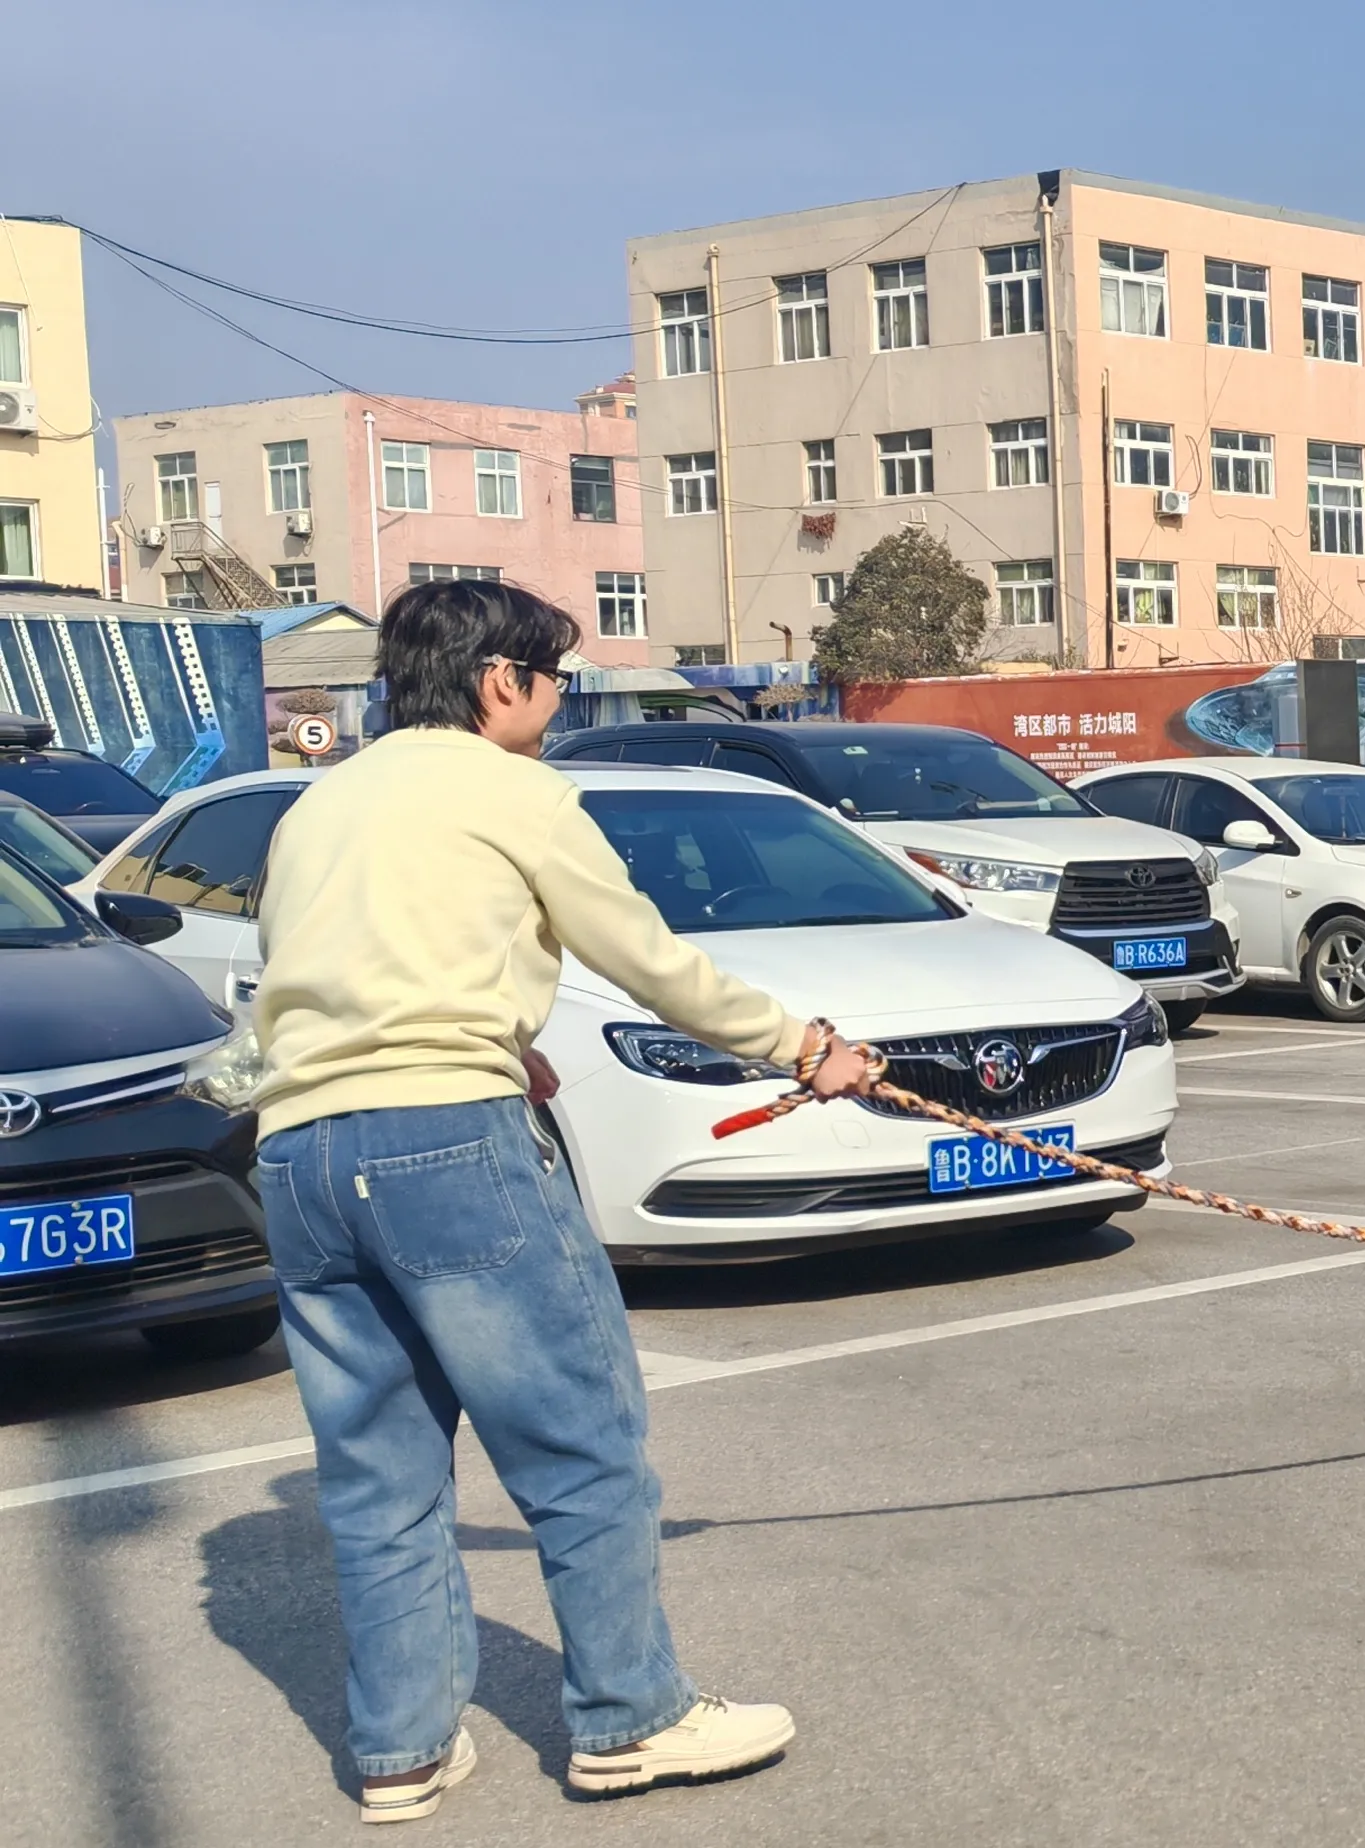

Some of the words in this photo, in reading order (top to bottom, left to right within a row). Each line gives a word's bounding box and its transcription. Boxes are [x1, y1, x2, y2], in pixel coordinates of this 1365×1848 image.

[308, 726, 323, 745] 5
[1013, 714, 1071, 737] 湾区都市
[1079, 711, 1137, 735] 活力城阳
[0, 1207, 127, 1263] 7G3R
